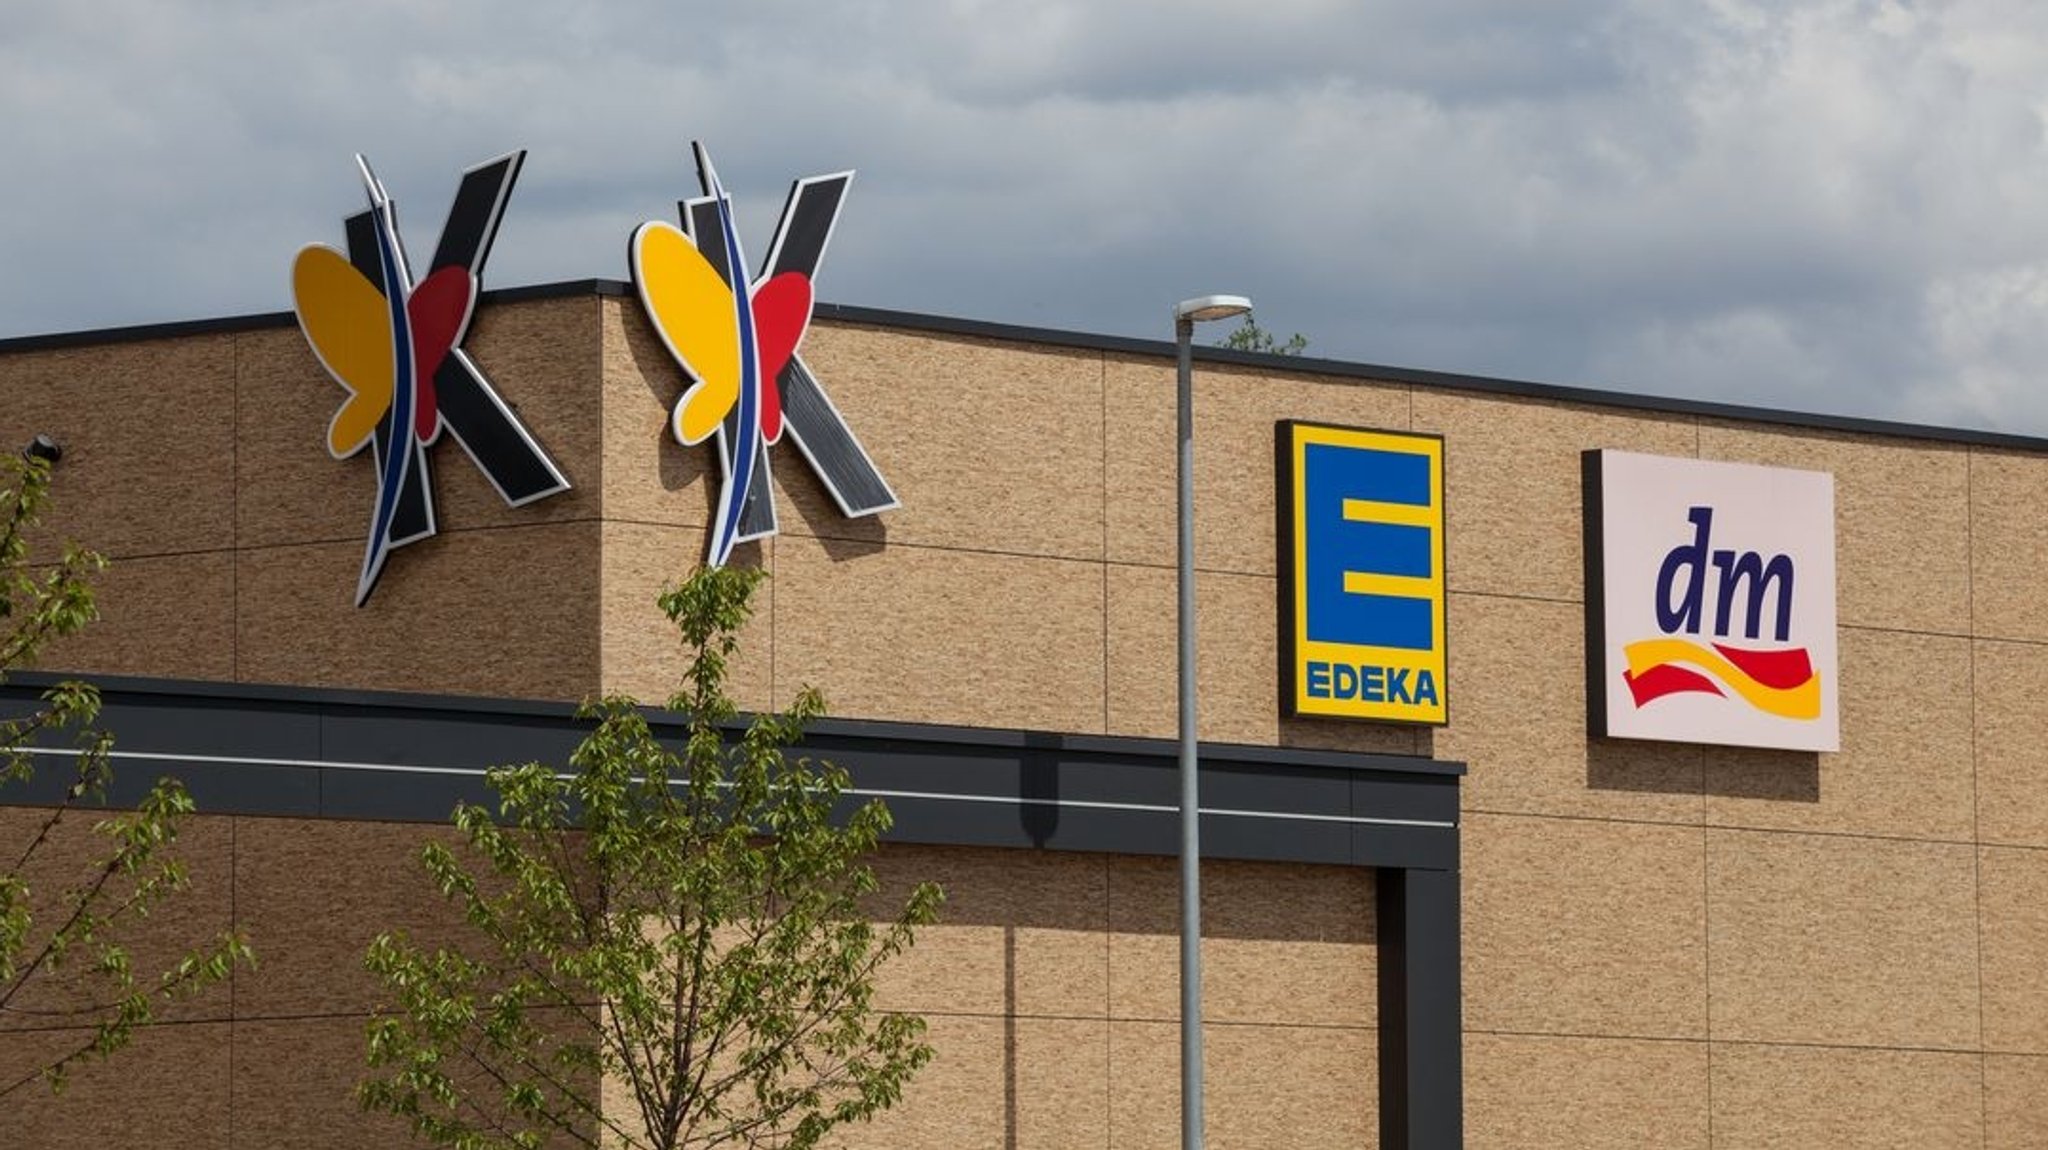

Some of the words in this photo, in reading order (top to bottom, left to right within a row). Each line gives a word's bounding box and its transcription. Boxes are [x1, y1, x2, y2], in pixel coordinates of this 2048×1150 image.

[1305, 442, 1433, 651] E
[1655, 506, 1794, 642] dm
[1306, 661, 1439, 706] EDEKA
